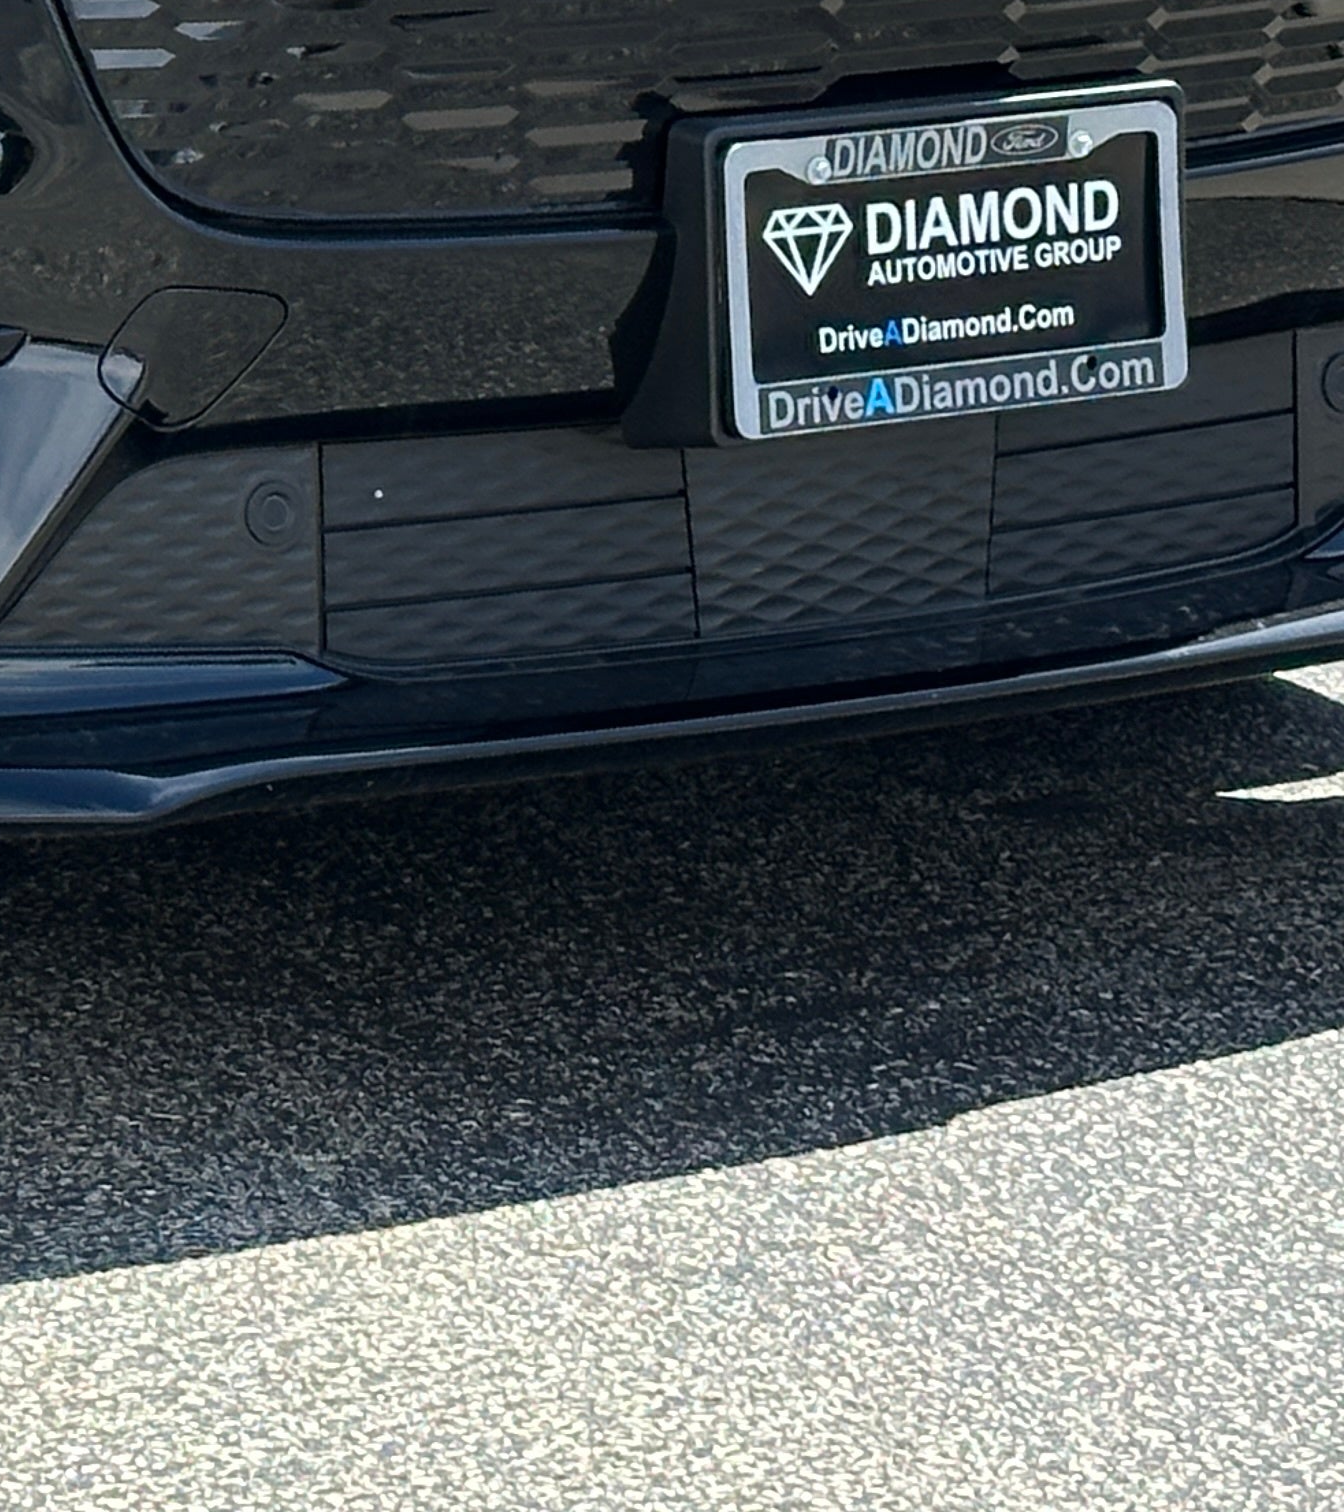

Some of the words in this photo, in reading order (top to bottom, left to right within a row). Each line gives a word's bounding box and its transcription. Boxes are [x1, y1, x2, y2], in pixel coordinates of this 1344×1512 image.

[832, 125, 987, 178] DIAMOND
[866, 180, 1120, 256] DIAMOND
[866, 250, 1029, 287] AUTOMOTIVE
[1037, 236, 1123, 269] GROUP
[818, 304, 1075, 355] DriveADiamond.Com
[767, 352, 1156, 430] DriveADiamond.Com
